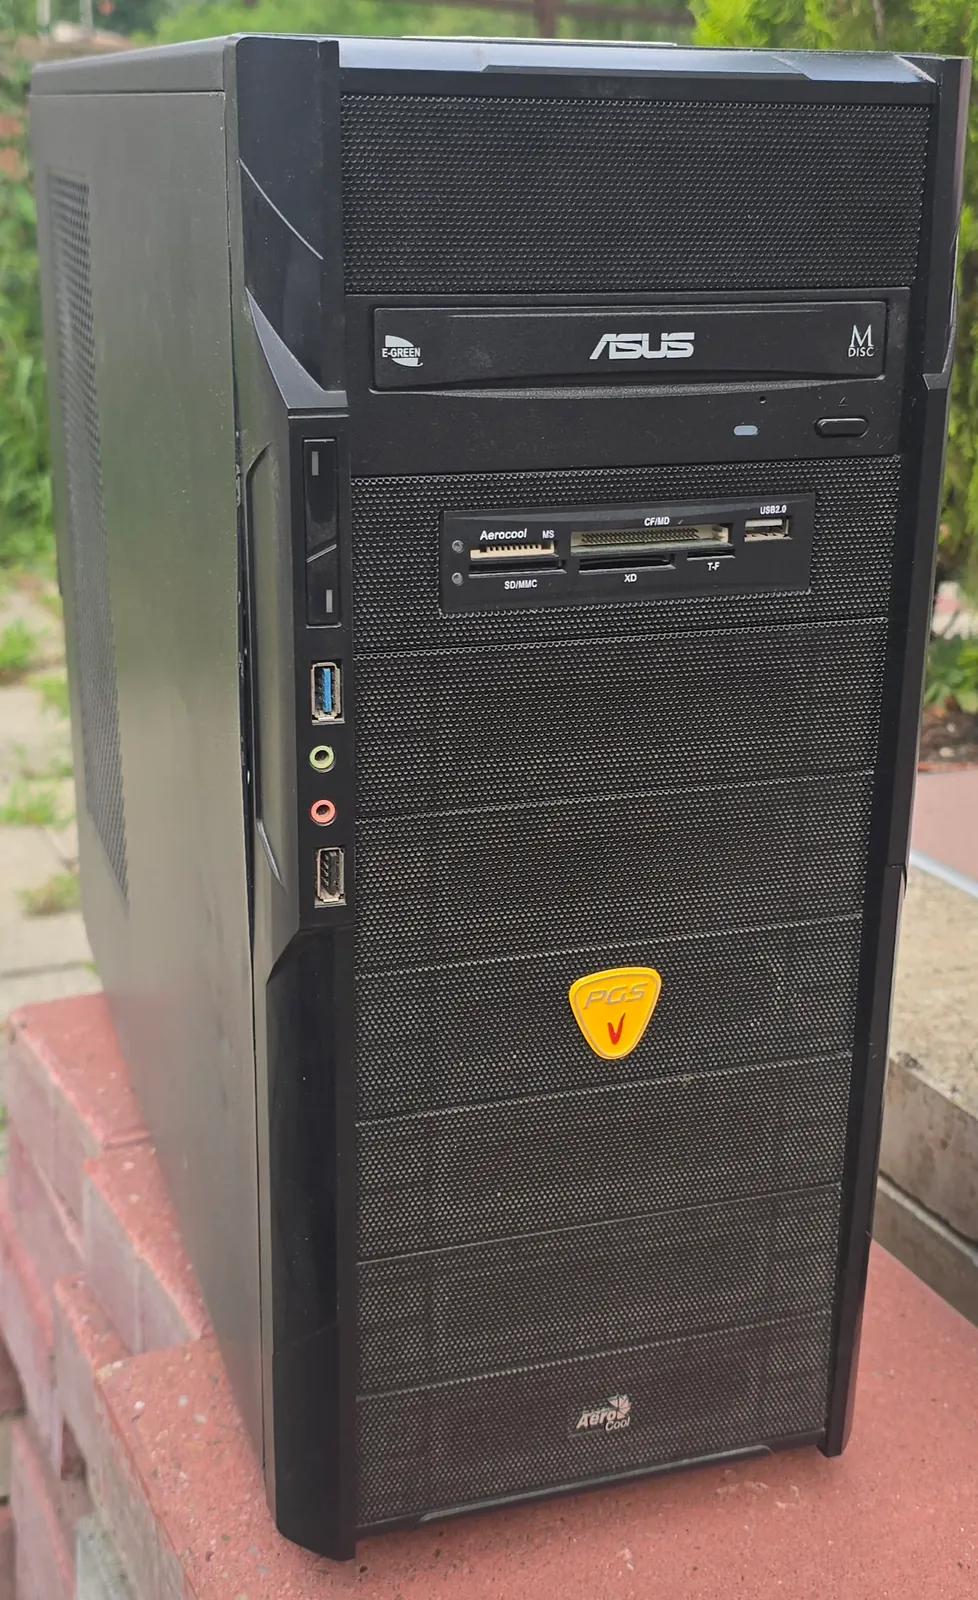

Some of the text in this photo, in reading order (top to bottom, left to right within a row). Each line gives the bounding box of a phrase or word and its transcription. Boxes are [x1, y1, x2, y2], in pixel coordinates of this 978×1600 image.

[849, 324, 875, 347] M
[589, 332, 695, 360] ASUS
[381, 347, 421, 358] E-GREEN
[847, 346, 875, 358] DISC
[760, 504, 788, 515] USB2.0
[644, 516, 670, 526] CF/MD
[479, 528, 528, 541] Aerocool
[542, 529, 555, 539] MS
[707, 562, 720, 571] T-F
[623, 573, 638, 583] XD
[504, 579, 538, 590] SD/MMC
[584, 982, 649, 1010] PGS
[576, 1409, 617, 1429] Aero
[605, 1416, 631, 1431] Cool
